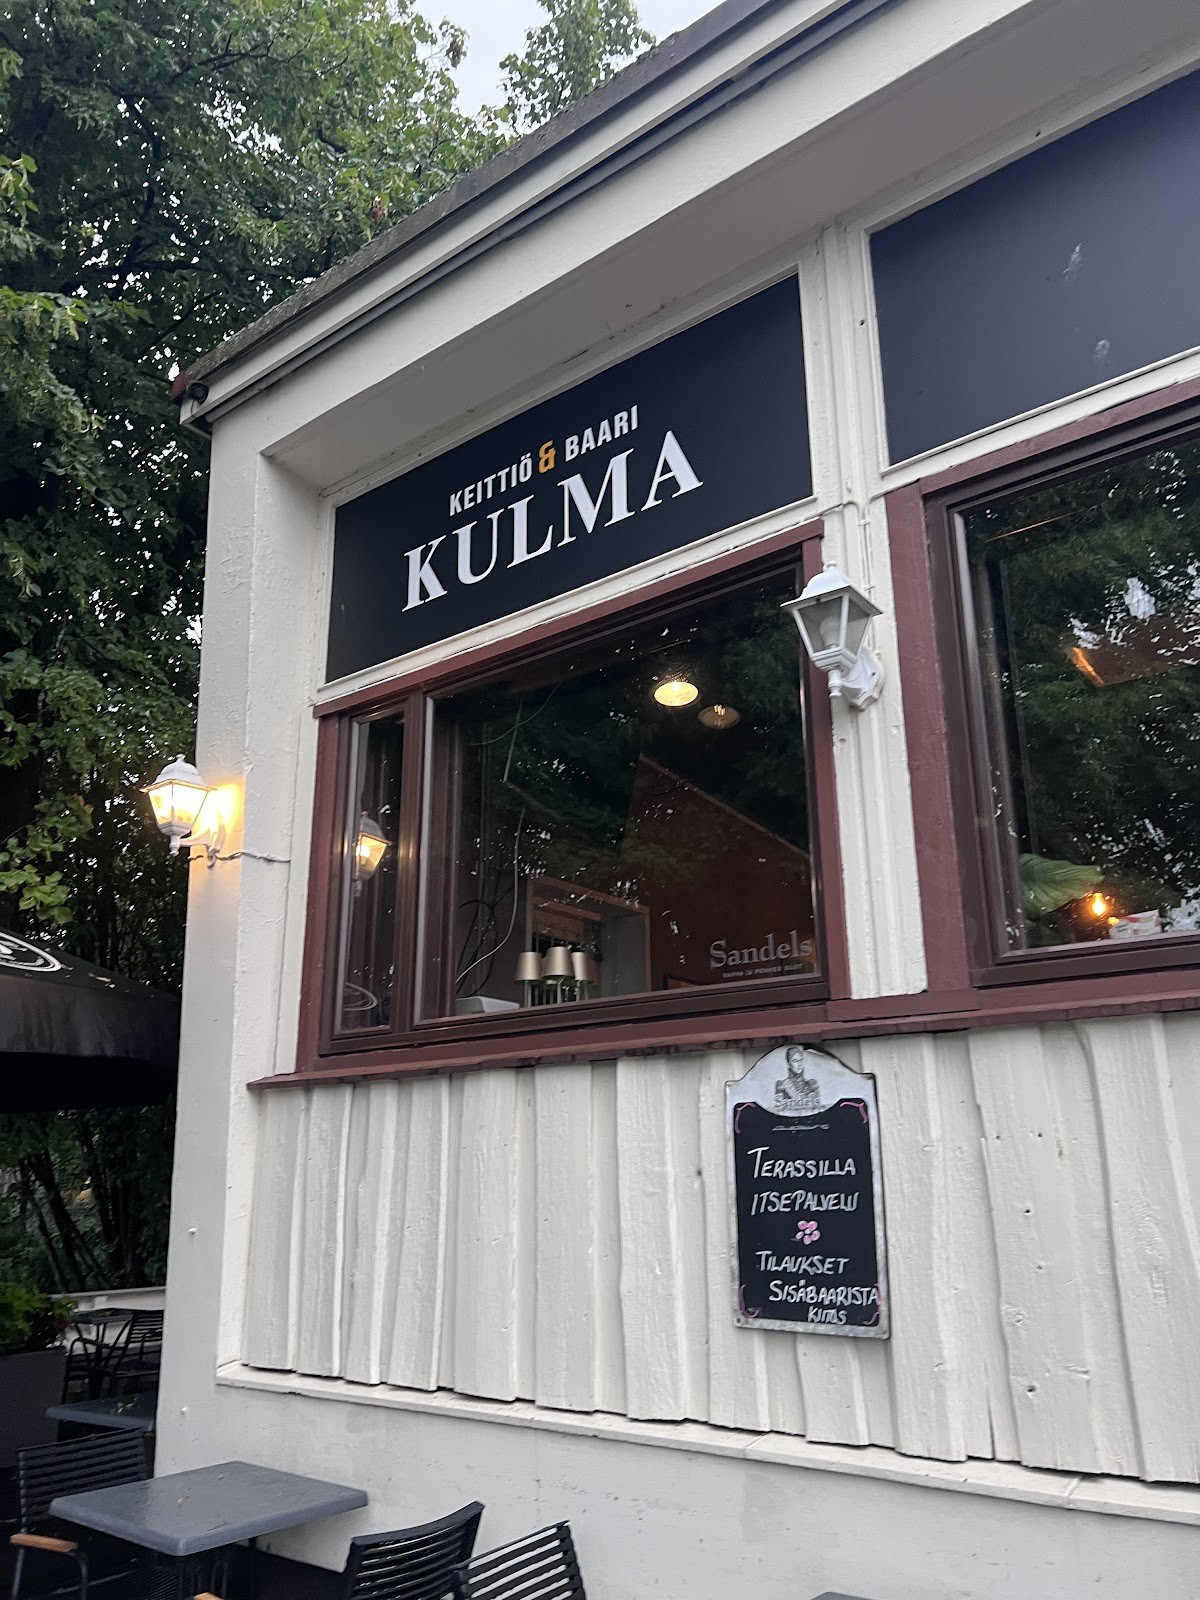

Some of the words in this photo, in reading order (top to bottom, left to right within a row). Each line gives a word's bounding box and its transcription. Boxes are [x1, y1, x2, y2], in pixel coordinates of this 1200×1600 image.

[449, 452, 533, 516] KEITTIÖ
[538, 440, 556, 474] &
[565, 404, 638, 462] BAARI
[402, 430, 704, 612] KULMA
[709, 929, 813, 969] Sandels
[747, 1146, 856, 1180] TERASSILLA
[751, 1189, 860, 1216] ITSEPALVELU
[755, 1250, 850, 1276] TILAUKSET
[768, 1279, 881, 1306] SISÄBAARISTA
